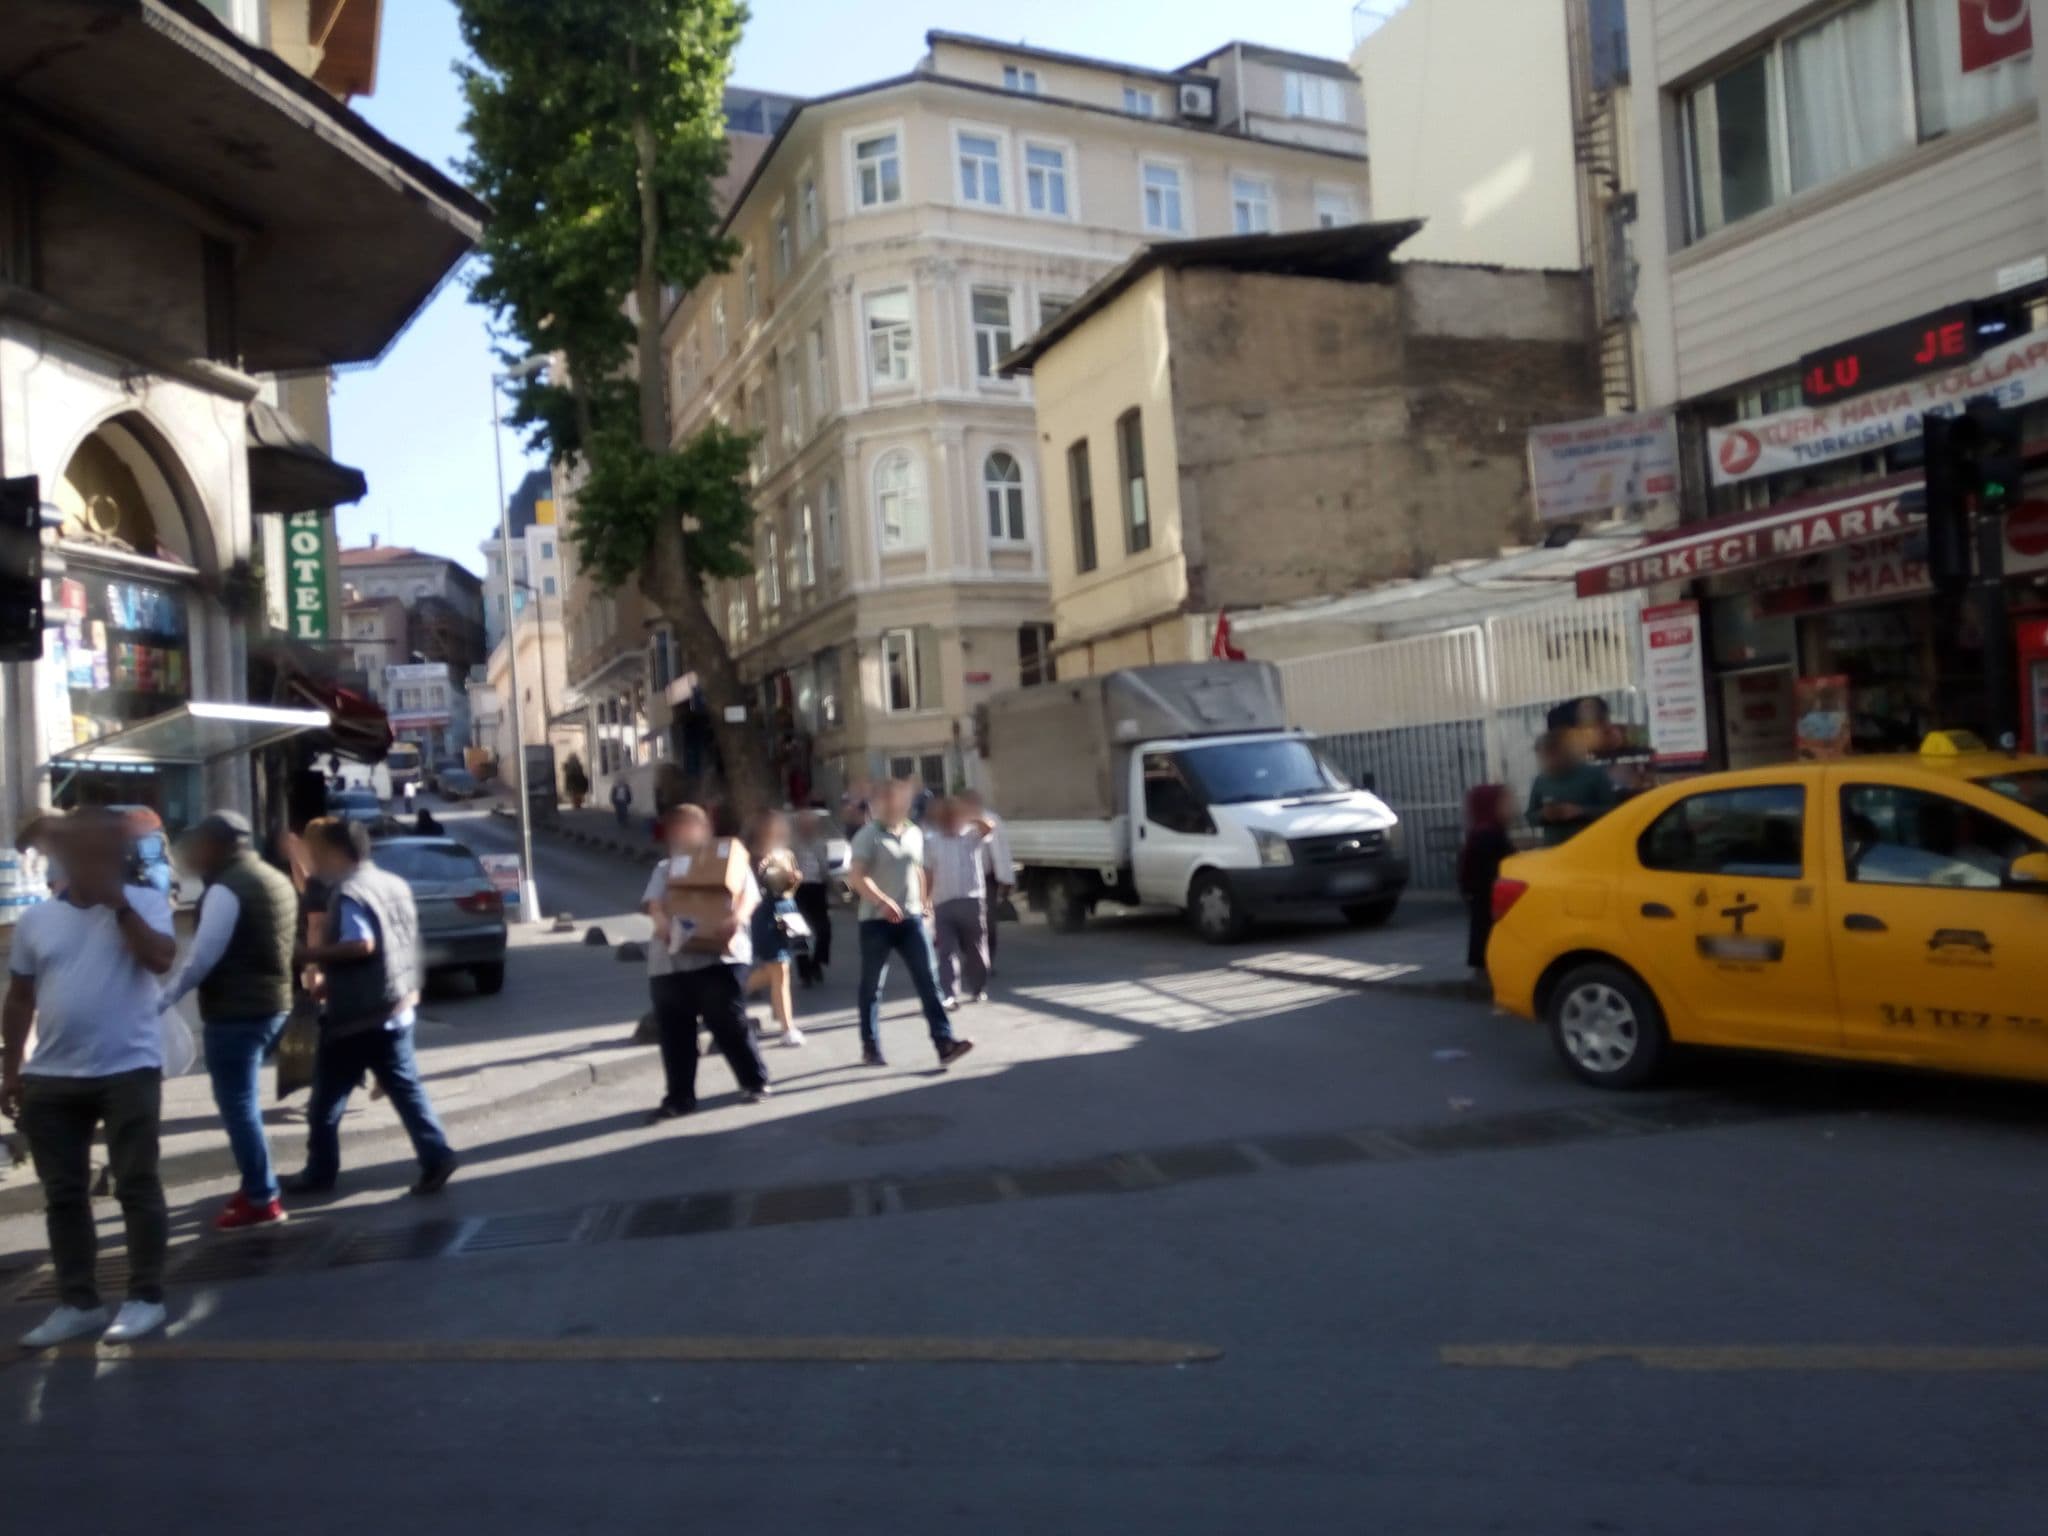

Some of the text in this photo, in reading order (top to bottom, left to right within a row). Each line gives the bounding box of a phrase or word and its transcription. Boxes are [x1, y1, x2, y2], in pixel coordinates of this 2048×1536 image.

[1791, 425, 1896, 463] TURKISH
[1772, 500, 1929, 553] MARK
[1847, 560, 1926, 596] MAR
